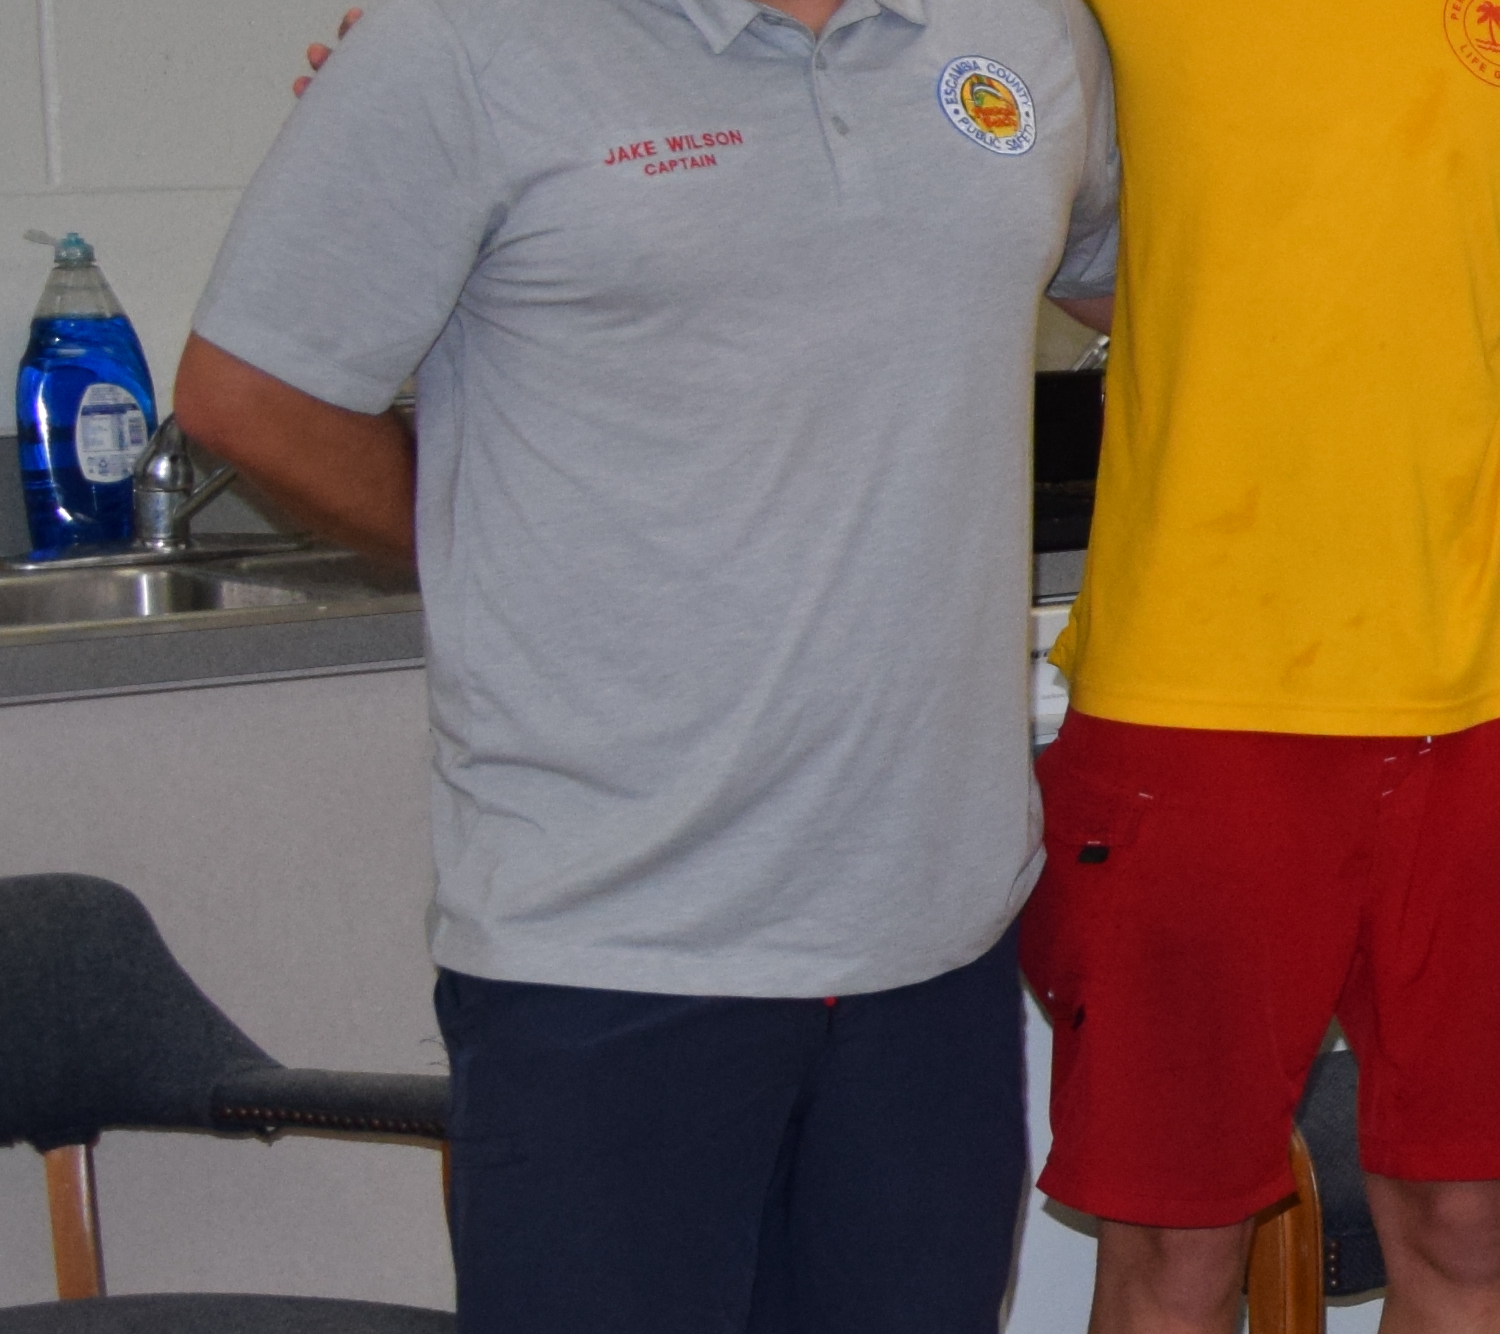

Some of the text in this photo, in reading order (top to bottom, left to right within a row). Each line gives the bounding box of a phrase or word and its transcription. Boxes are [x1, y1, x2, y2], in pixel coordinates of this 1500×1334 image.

[1459, 44, 1487, 73] LIFE
[944, 59, 1031, 107] ESCAMBIA COUNTY
[604, 129, 743, 165] JAKE WILSON
[958, 116, 1002, 149] PUBLIC
[643, 154, 717, 176] CAPTAIN
